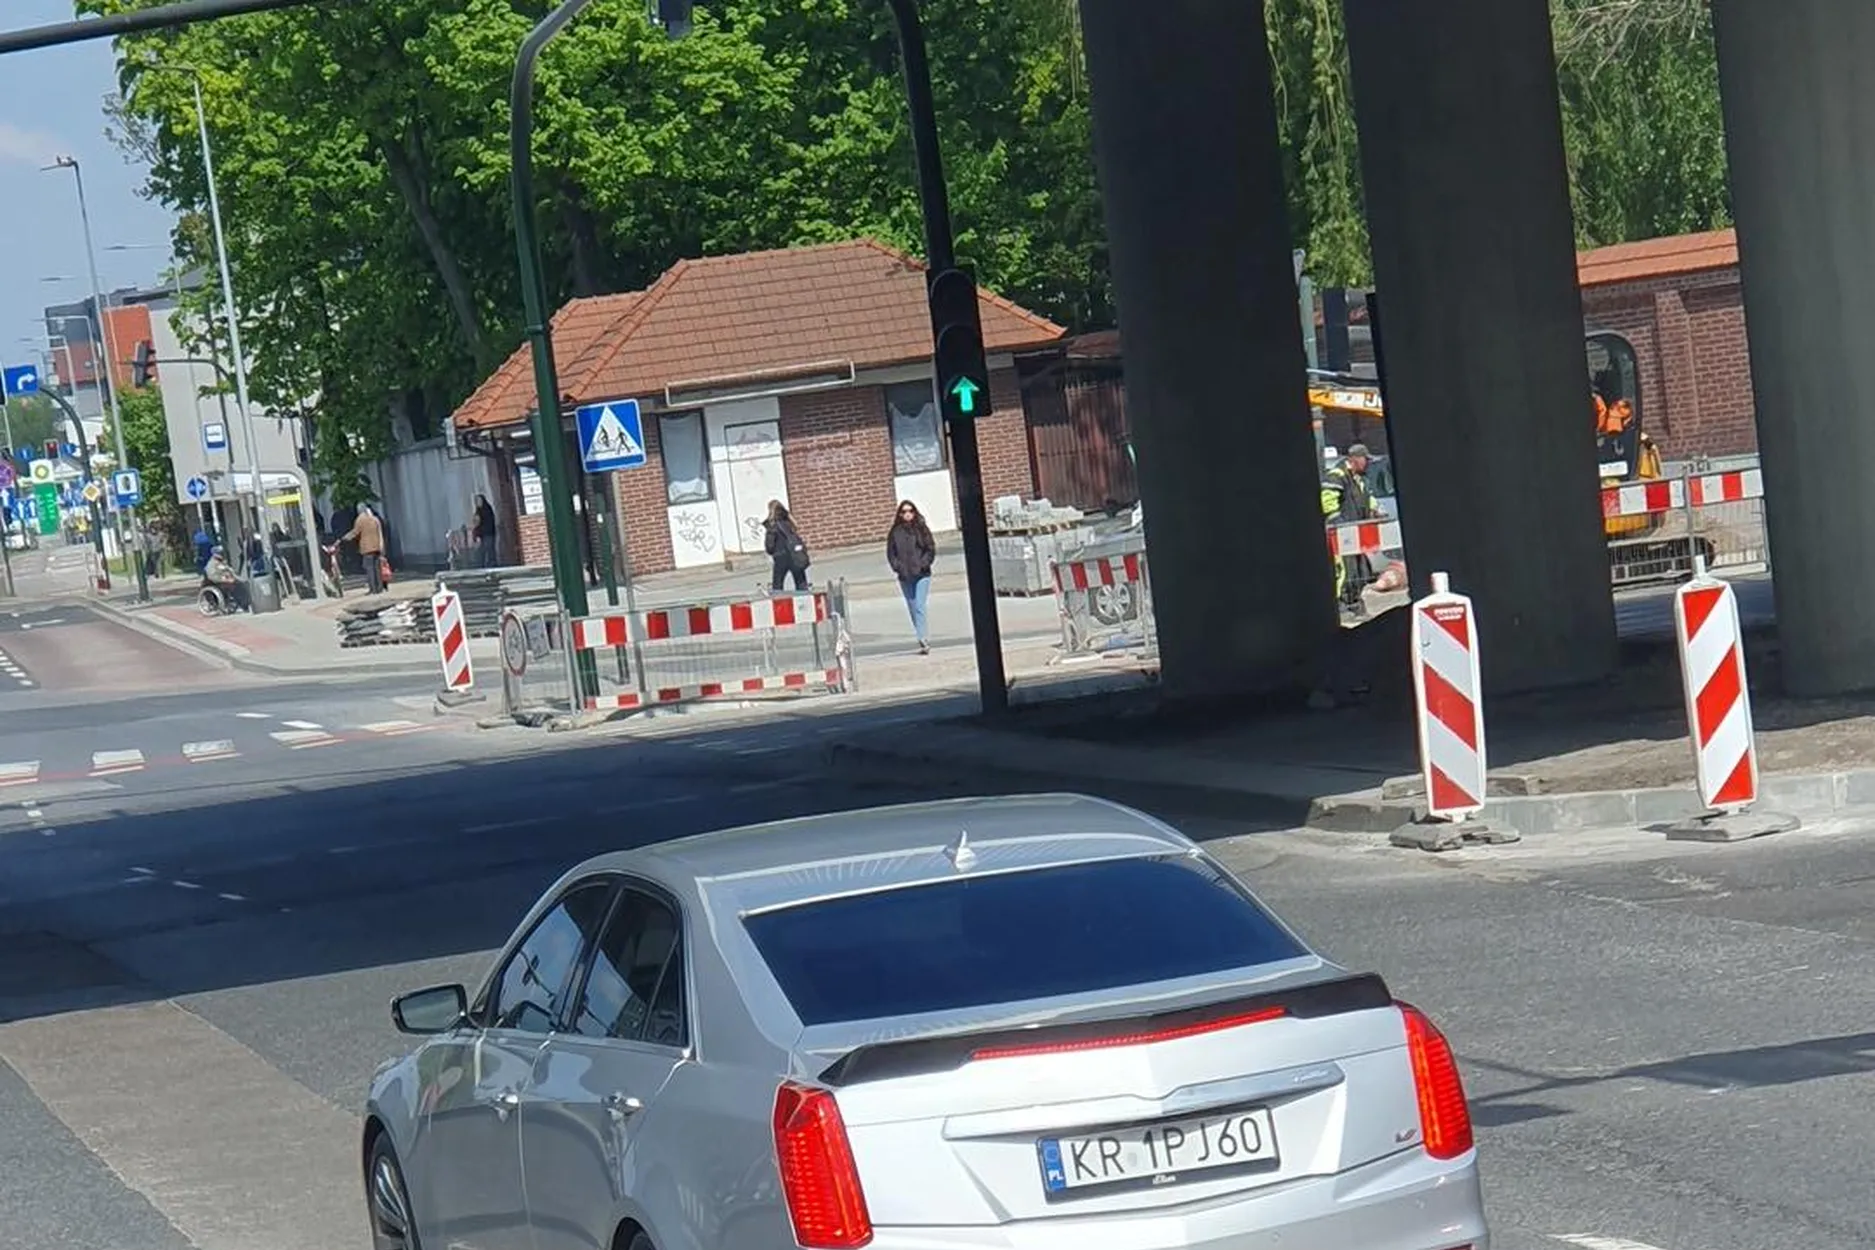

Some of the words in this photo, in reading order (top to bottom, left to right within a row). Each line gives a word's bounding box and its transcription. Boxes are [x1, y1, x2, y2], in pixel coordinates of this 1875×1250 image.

[1071, 1137, 1125, 1180] KR
[1143, 1117, 1262, 1169] 1PJ60
[1048, 1170, 1063, 1181] PL
